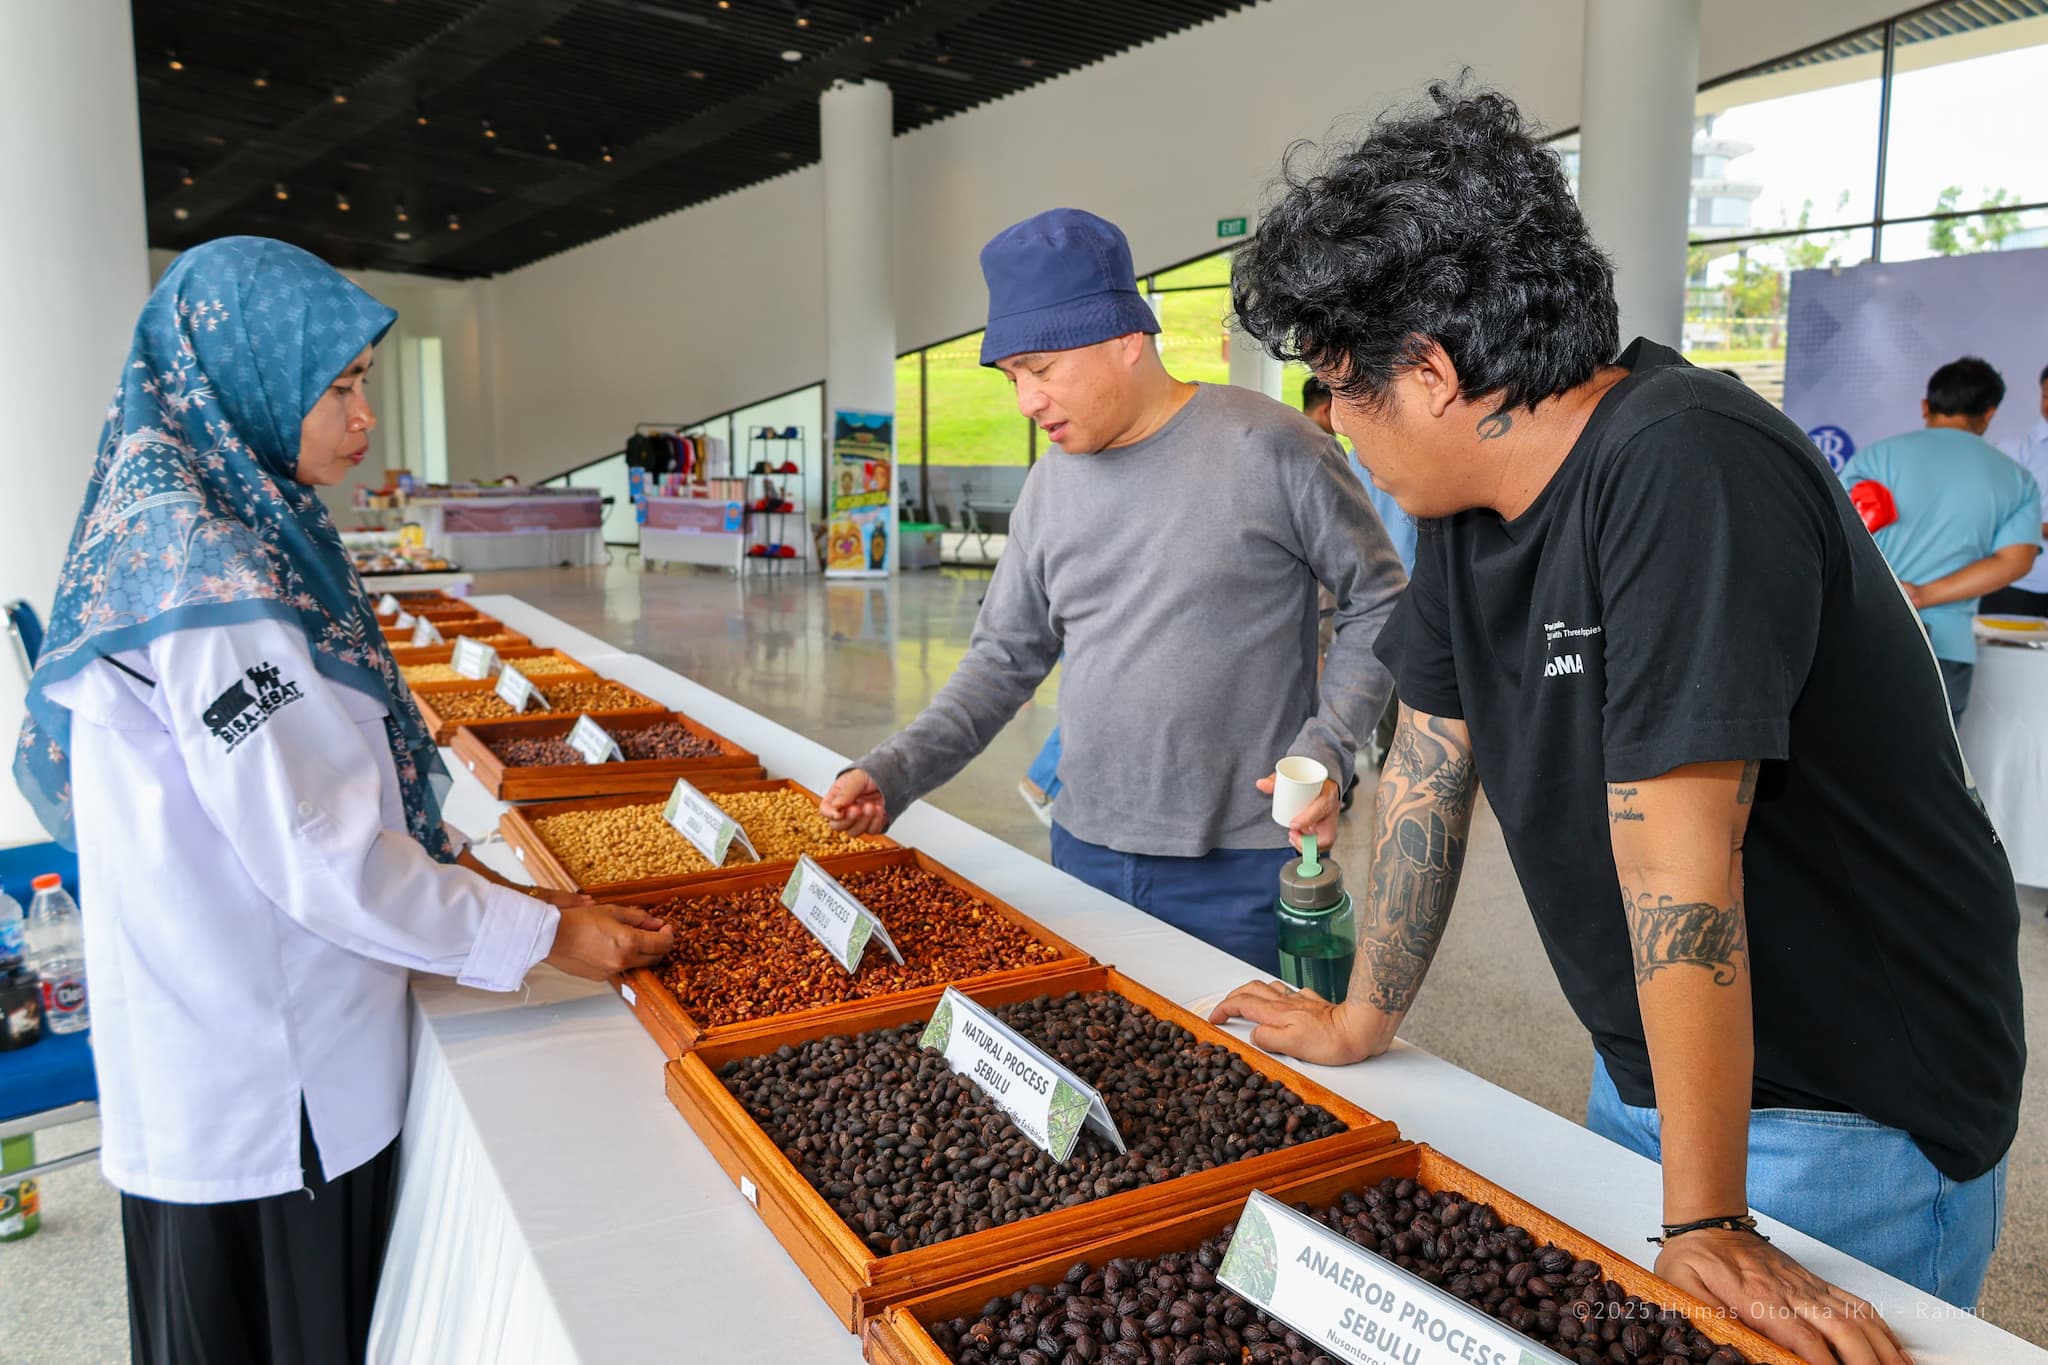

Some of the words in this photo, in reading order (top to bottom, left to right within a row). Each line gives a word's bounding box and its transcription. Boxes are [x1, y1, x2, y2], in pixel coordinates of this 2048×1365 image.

[1221, 219, 1242, 235] EXIT
[808, 881, 828, 903] HONEY
[825, 895, 851, 924] PROCESS
[810, 905, 831, 929] SEBULU
[962, 1020, 1004, 1061] NATURAL
[1003, 1051, 1049, 1095] PROCESS
[974, 1059, 1011, 1095] SEBULU
[1296, 1245, 1395, 1314] ANAEROB
[1326, 1329, 1380, 1365] Nusantara
[1339, 1307, 1421, 1365] SEBULU
